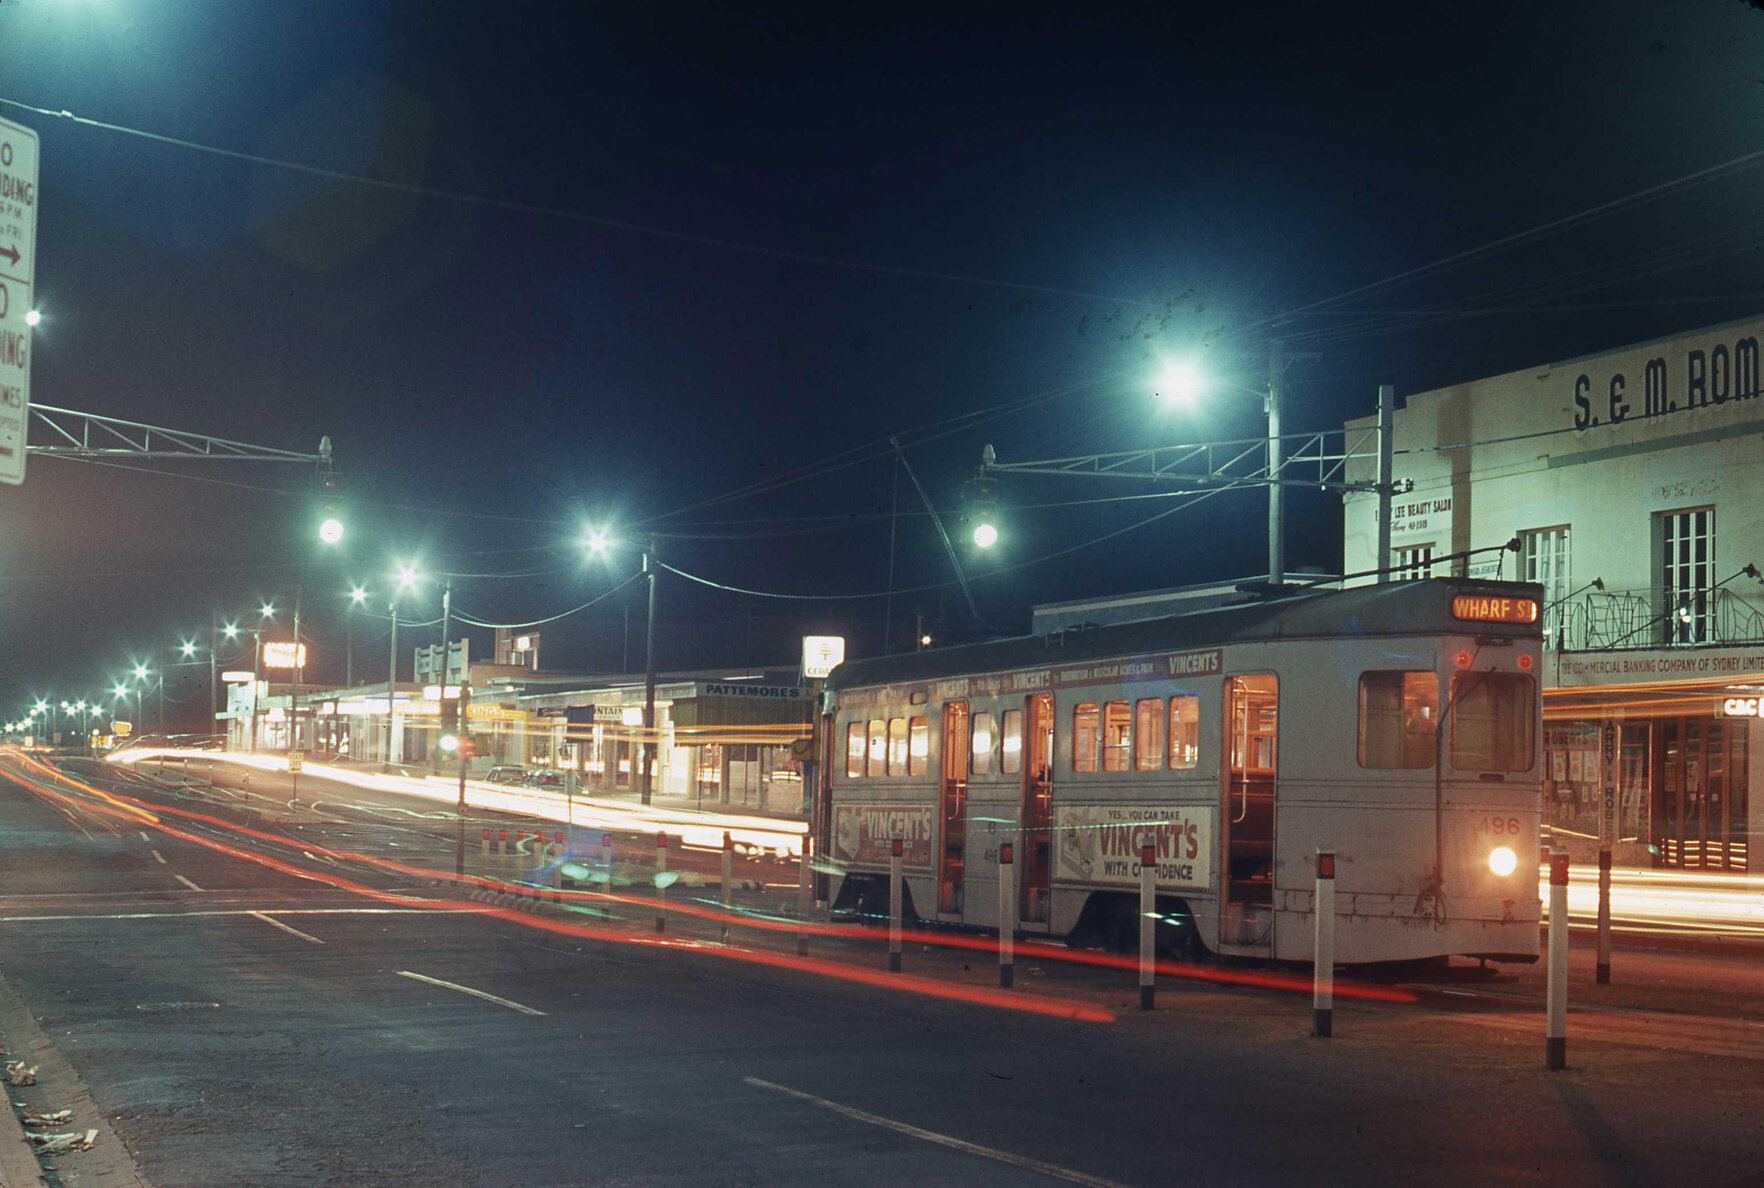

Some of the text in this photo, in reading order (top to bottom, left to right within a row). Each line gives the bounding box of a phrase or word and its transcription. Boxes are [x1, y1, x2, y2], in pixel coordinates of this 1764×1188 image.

[1575, 373, 1598, 431] S.
[1610, 373, 1630, 424] &
[1645, 357, 1676, 418] M.
[1394, 505, 1406, 519] LEE
[1407, 501, 1432, 517] BEAUTY
[1433, 498, 1452, 512] SALON
[1454, 598, 1511, 618] WHARF
[1573, 660, 1621, 675] COMMERCIAL
[1623, 659, 1656, 673] BANKING
[1658, 657, 1696, 673] COMPANY
[1698, 657, 1709, 671] OF
[1712, 656, 1740, 671] SYDNEY
[706, 684, 800, 698] PATTEMORES
[867, 808, 931, 841] VINCENT'S
[1129, 811, 1142, 820] YOU
[1144, 810, 1158, 820] CAN
[1160, 811, 1180, 821] TAKE
[1104, 860, 1128, 877] WITH
